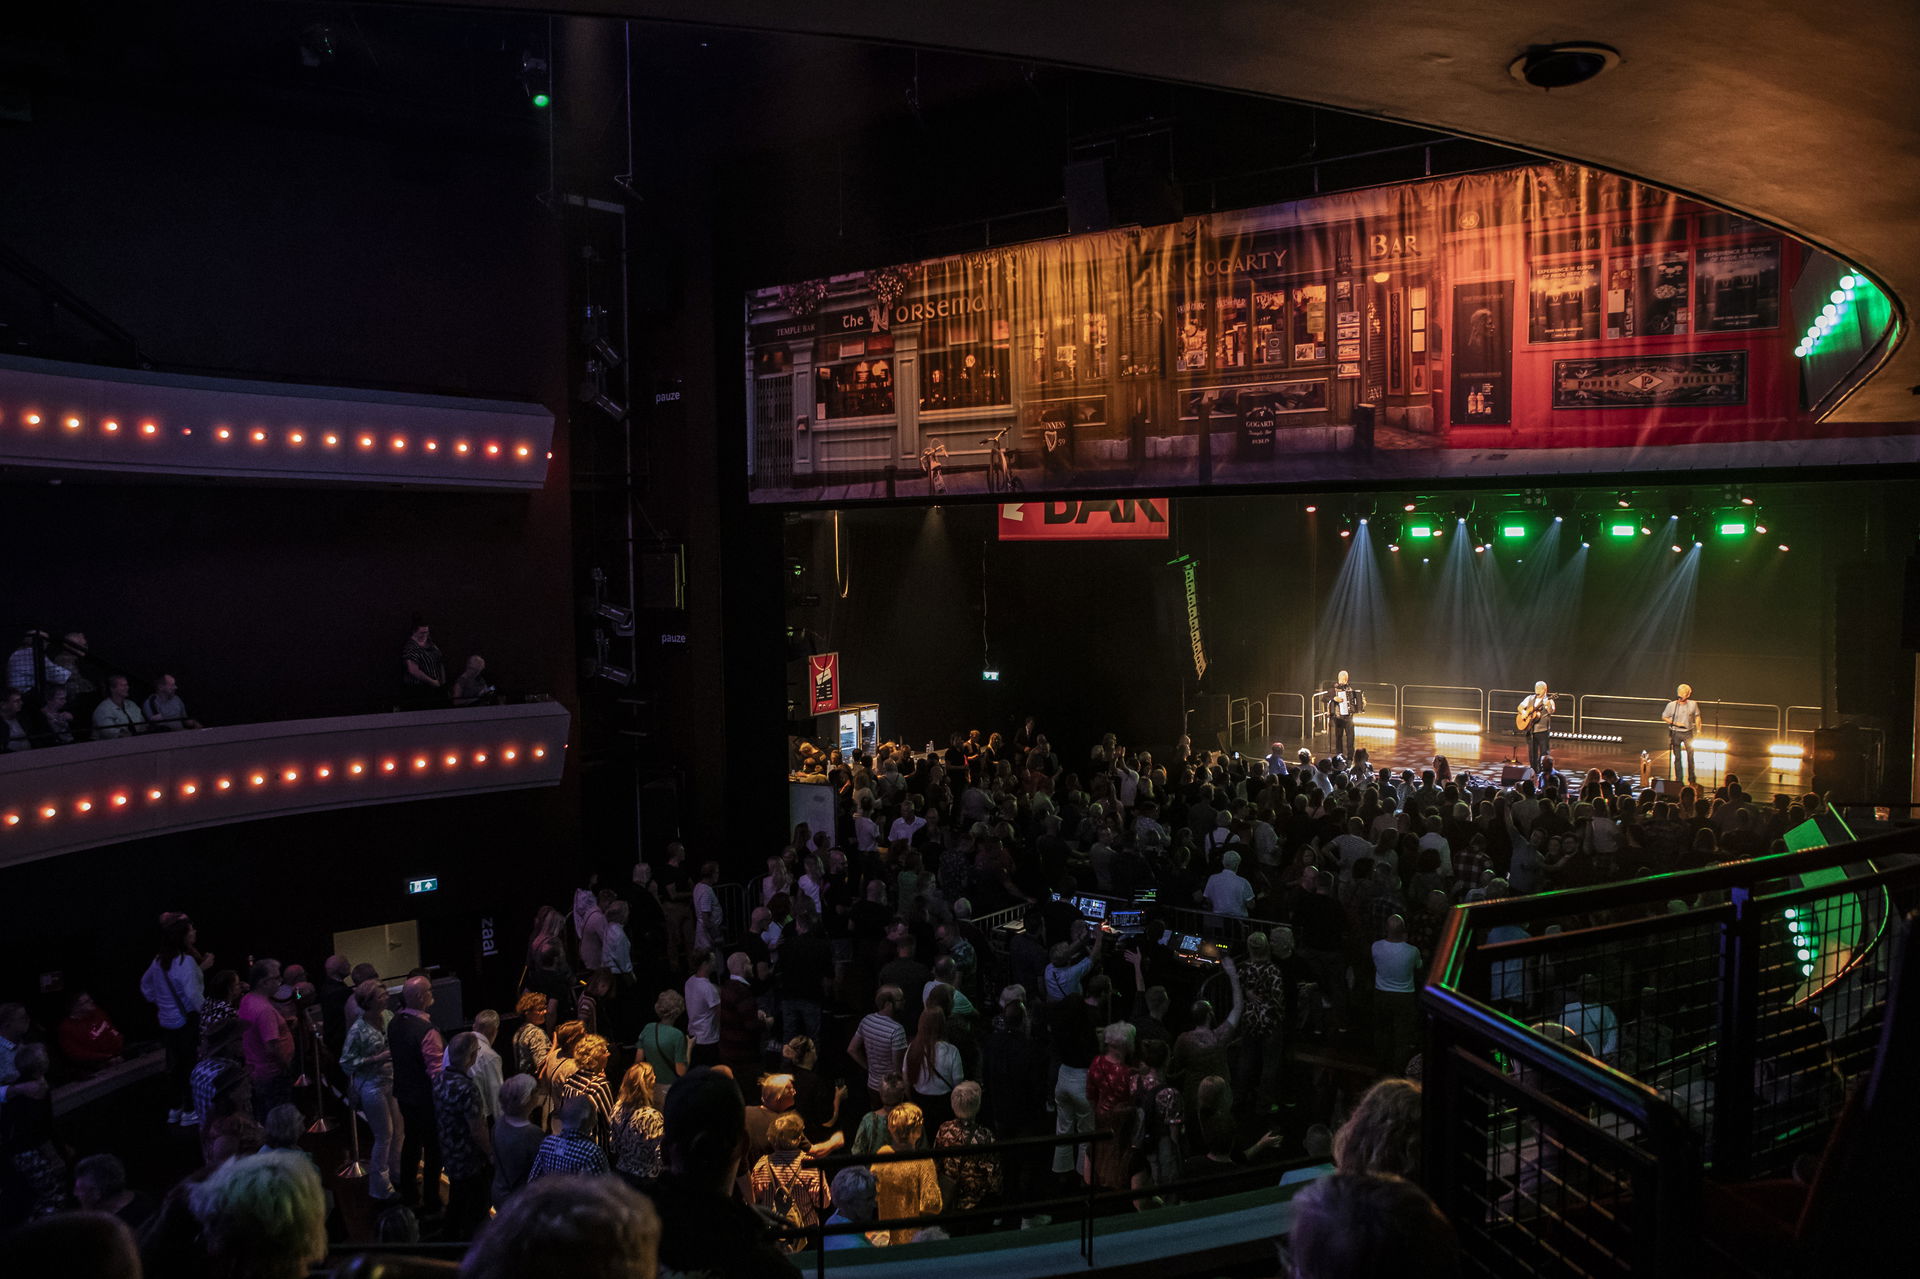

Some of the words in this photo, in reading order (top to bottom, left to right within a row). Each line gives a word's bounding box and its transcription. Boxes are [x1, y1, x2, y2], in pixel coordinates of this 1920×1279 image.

[1370, 234, 1421, 259] BAR
[842, 312, 864, 329] The
[776, 325, 801, 337] TEMPLE
[656, 390, 681, 405] pauze
[661, 632, 686, 645] pauze
[481, 917, 499, 958] zaal
